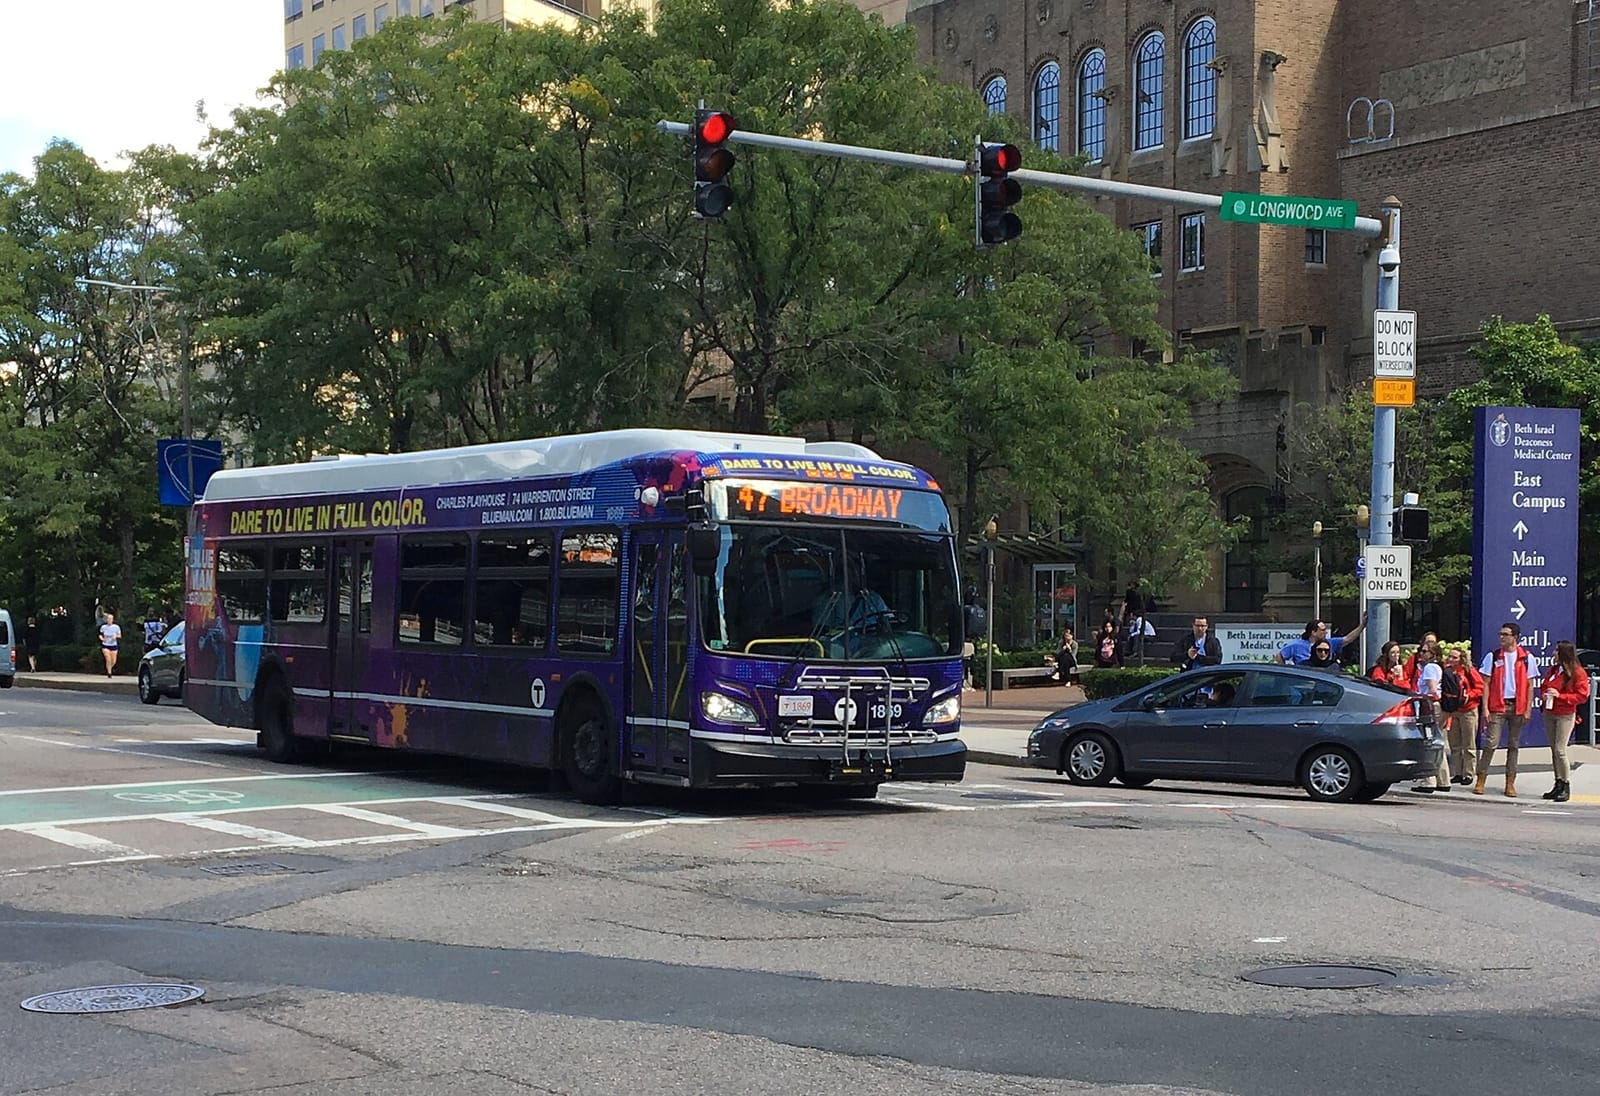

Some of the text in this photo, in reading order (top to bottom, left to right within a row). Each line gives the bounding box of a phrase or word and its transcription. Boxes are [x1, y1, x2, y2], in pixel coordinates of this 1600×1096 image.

[1250, 201, 1343, 220] LONGWOOD AVE
[1378, 320, 1413, 335] DO NOT
[1378, 341, 1413, 356] BLOCK
[1378, 360, 1413, 371] INTERSECTION
[1514, 423, 1554, 434] Beth Israel
[1514, 436, 1553, 446] Deaconess
[1514, 449, 1572, 460] Medical Center
[721, 459, 917, 481] DARE TO LIVE IN FULL COLOR.
[1513, 470, 1542, 487] East
[436, 487, 597, 510] CHARLES PLAYHOUSE 74 WARRENTON STREET
[780, 485, 902, 518] BROADWAY
[1512, 491, 1566, 513] Campus
[230, 498, 426, 534] DARE TO LIVE IN FULL COLOR.
[481, 505, 594, 524] BLUEMAN.COM 1.800.BLUEMAN
[1380, 554, 1396, 564] NO
[1512, 550, 1545, 566] Main
[1374, 567, 1402, 577] TURN
[1512, 571, 1568, 587] Entrance
[1368, 580, 1407, 590] ON RED
[1227, 631, 1300, 640] Beth Israel Deaco
[1519, 630, 1551, 650] arl J.
[1240, 641, 1274, 650] Medical
[792, 702, 811, 712] 1869
